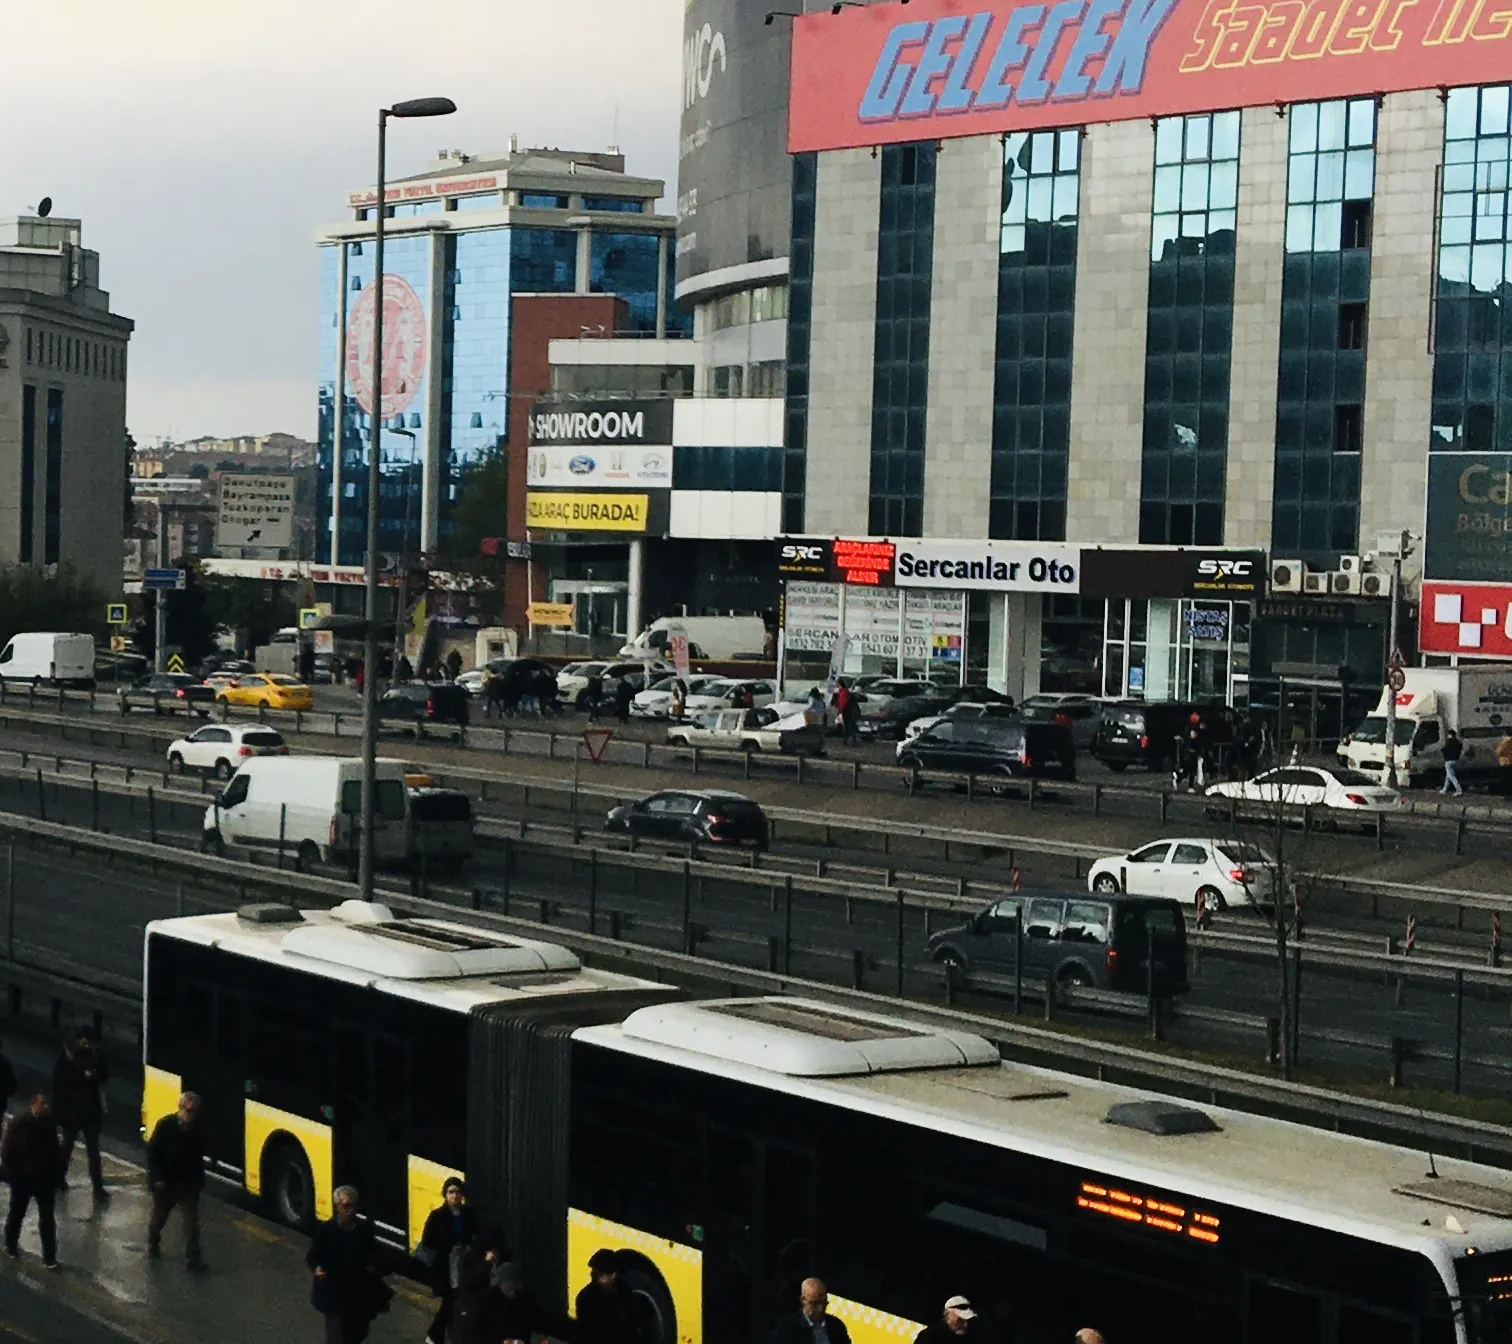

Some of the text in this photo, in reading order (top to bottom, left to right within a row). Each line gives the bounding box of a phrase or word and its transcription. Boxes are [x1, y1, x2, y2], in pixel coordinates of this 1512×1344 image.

[535, 411, 644, 440] SHOWROOM
[573, 503, 640, 522] BURADA!
[781, 545, 824, 560] SRC
[898, 552, 1075, 583] Sercanlar Oto
[1197, 559, 1253, 575] SRC
